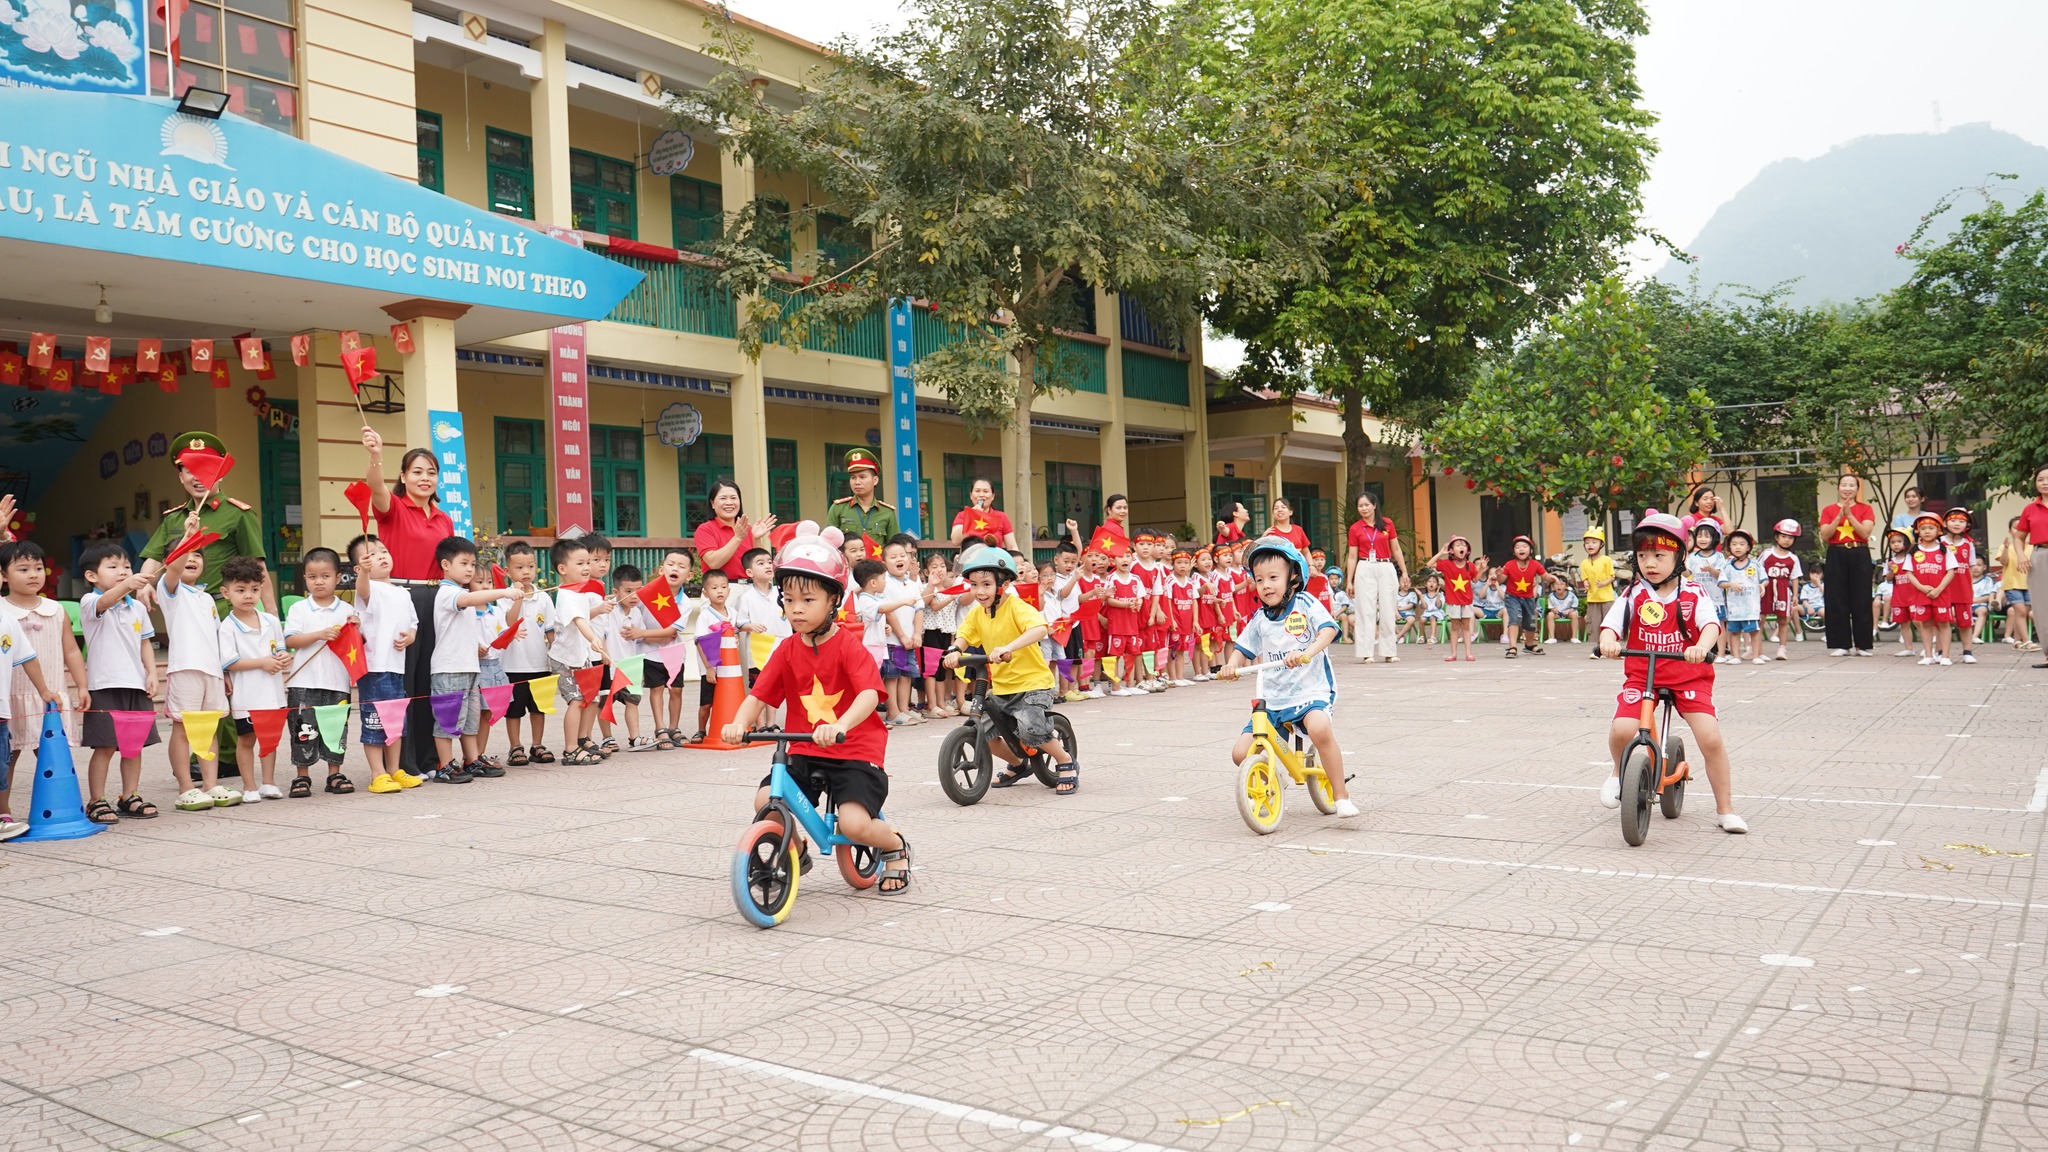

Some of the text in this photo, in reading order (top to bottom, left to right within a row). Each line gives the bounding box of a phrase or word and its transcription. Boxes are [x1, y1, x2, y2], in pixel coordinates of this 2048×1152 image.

[20, 145, 98, 182] NGŨ
[107, 161, 180, 197] NHÀ
[188, 177, 266, 211] GIÁO
[272, 190, 315, 221] VÀ
[322, 200, 380, 233] CÁN
[386, 211, 420, 244] BỘ
[426, 219, 495, 253] QUẢN
[500, 232, 530, 258] LÝ
[53, 191, 100, 225] LÀ
[109, 197, 182, 238] TẤM
[189, 216, 295, 254] GƯƠNG
[302, 236, 358, 264] CHO
[365, 246, 417, 276] HỌC
[423, 256, 480, 284] SINH
[485, 266, 526, 291] NOI
[530, 273, 586, 300] THEO
[560, 345, 578, 359] MẦM
[562, 371, 577, 383] NON
[558, 395, 582, 408] THÀNH
[562, 419, 580, 431] NGÔI
[564, 443, 580, 455] NHÀ
[565, 467, 580, 479] VĂN
[566, 492, 582, 504] HÓA
